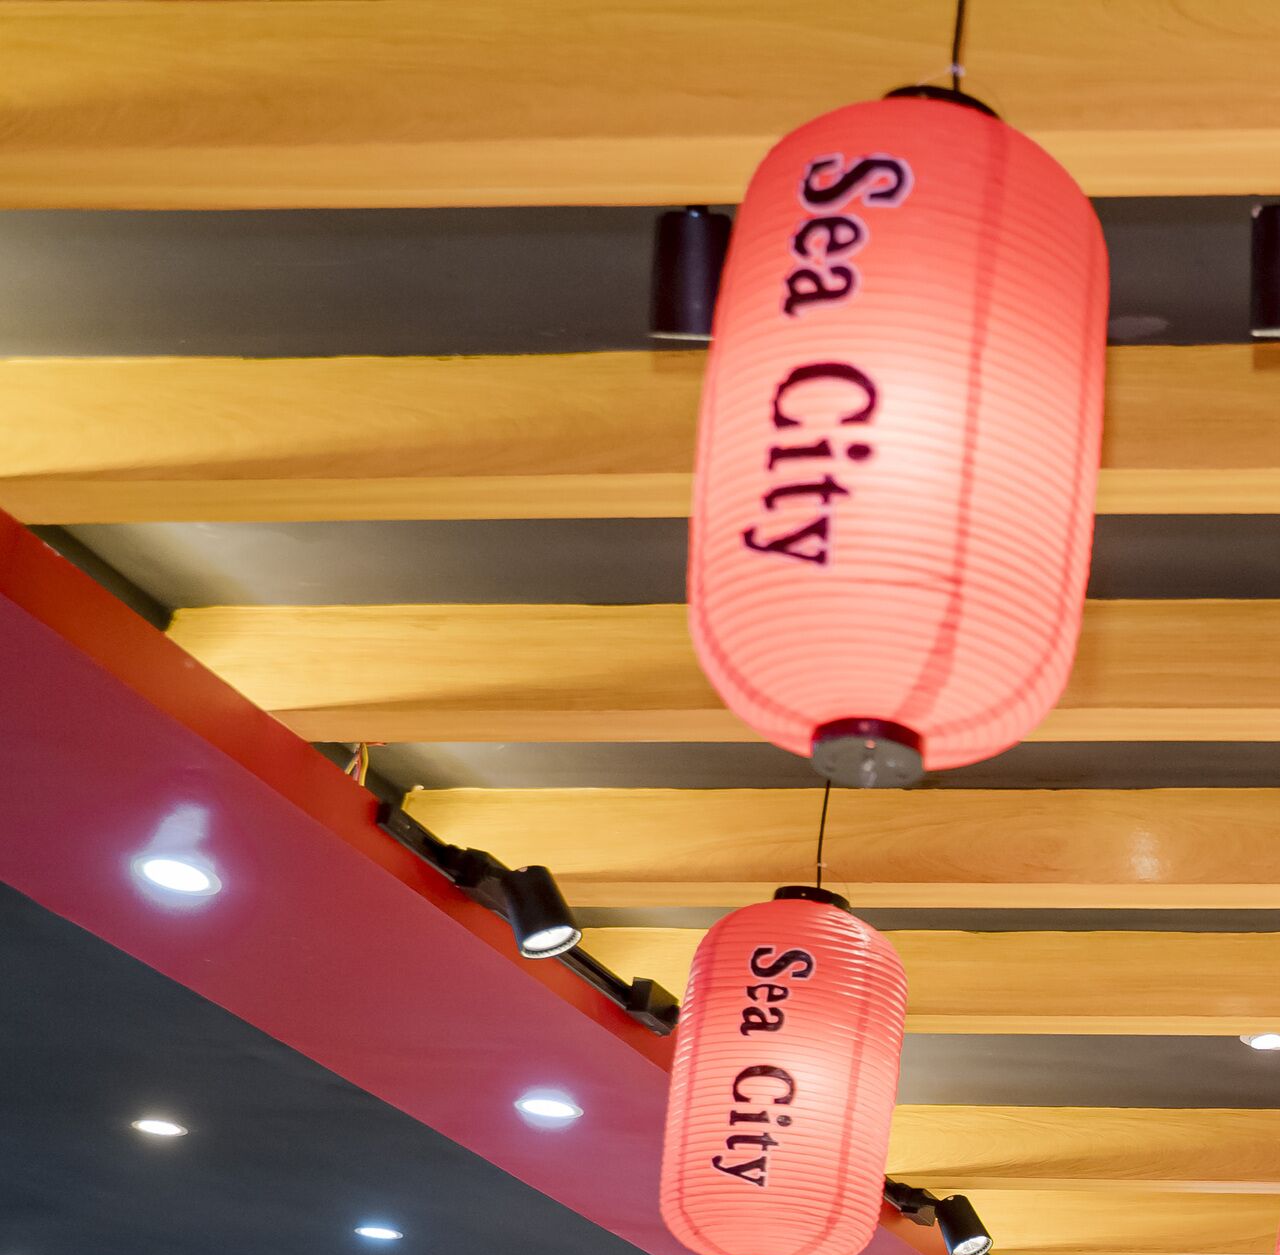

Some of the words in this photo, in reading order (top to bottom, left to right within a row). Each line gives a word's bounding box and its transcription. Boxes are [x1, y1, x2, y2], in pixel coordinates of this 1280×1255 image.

[783, 157, 907, 317] Sea
[743, 362, 878, 566] City
[740, 947, 814, 1036] Sea
[712, 1065, 795, 1187] City
